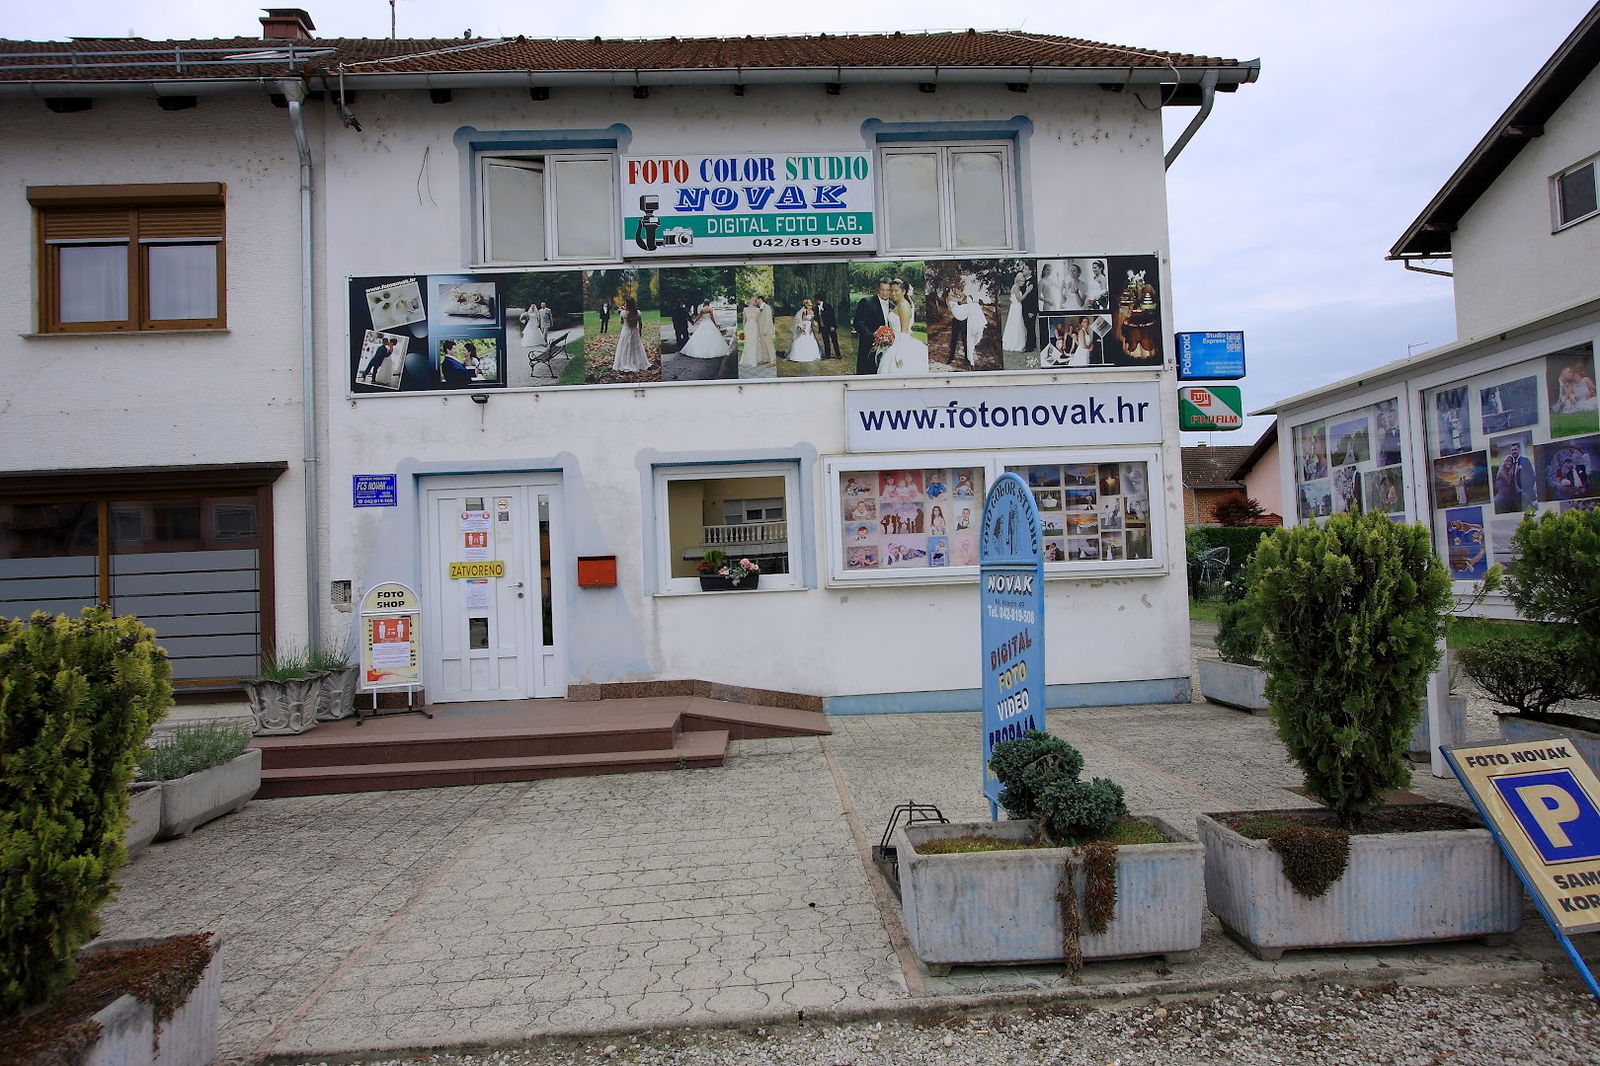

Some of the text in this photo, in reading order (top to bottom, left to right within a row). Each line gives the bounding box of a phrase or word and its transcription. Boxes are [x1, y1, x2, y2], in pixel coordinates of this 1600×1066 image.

[627, 156, 868, 184] FOTO COLOR STUDIO
[674, 184, 848, 212] NOVAK
[707, 215, 863, 234] DIGITAL FOTO LAB.
[752, 237, 862, 248] 042/819-508
[1182, 334, 1192, 375] Polaroid
[859, 396, 1149, 431] www.fotonovak.hr
[357, 481, 368, 490] FCS
[991, 481, 1016, 508] COLOR
[1017, 488, 1038, 555] STUDIO
[451, 564, 503, 577] ZATVORENO
[988, 574, 1034, 597] NOVAK
[990, 627, 1032, 672] DIGITAL
[998, 660, 1026, 694] FOTO
[997, 687, 1029, 721] VIDEO
[1465, 746, 1572, 768] FOTO NOVAK
[1514, 784, 1581, 848] P
[1557, 893, 1600, 912] KOR
